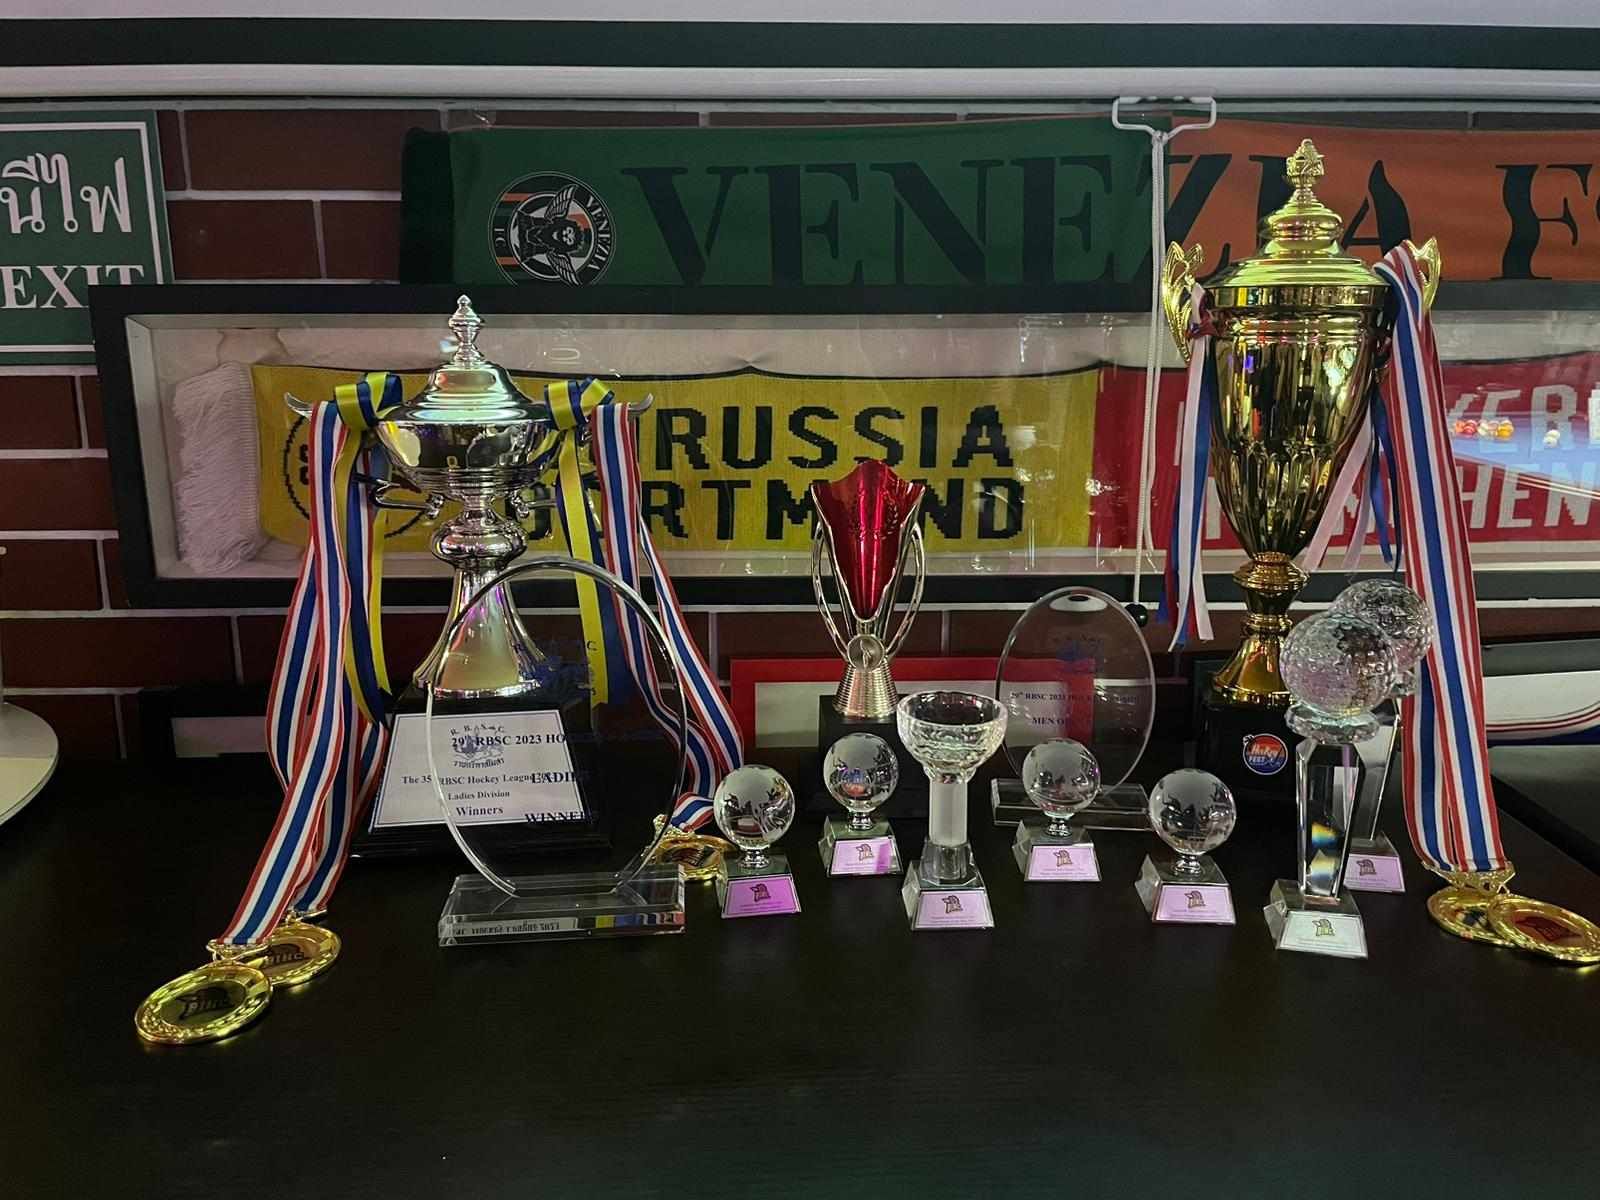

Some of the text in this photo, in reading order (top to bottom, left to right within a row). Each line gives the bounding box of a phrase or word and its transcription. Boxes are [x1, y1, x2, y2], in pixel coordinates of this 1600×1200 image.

[1489, 163, 1600, 281] F
[586, 195, 611, 271] VENEZIA
[475, 735, 512, 746] RBSC
[516, 734, 542, 745] 2023
[401, 776, 420, 785] The
[467, 773, 499, 784] Hockey
[448, 790, 510, 801] Ladies Division
[456, 806, 504, 817] Winners
